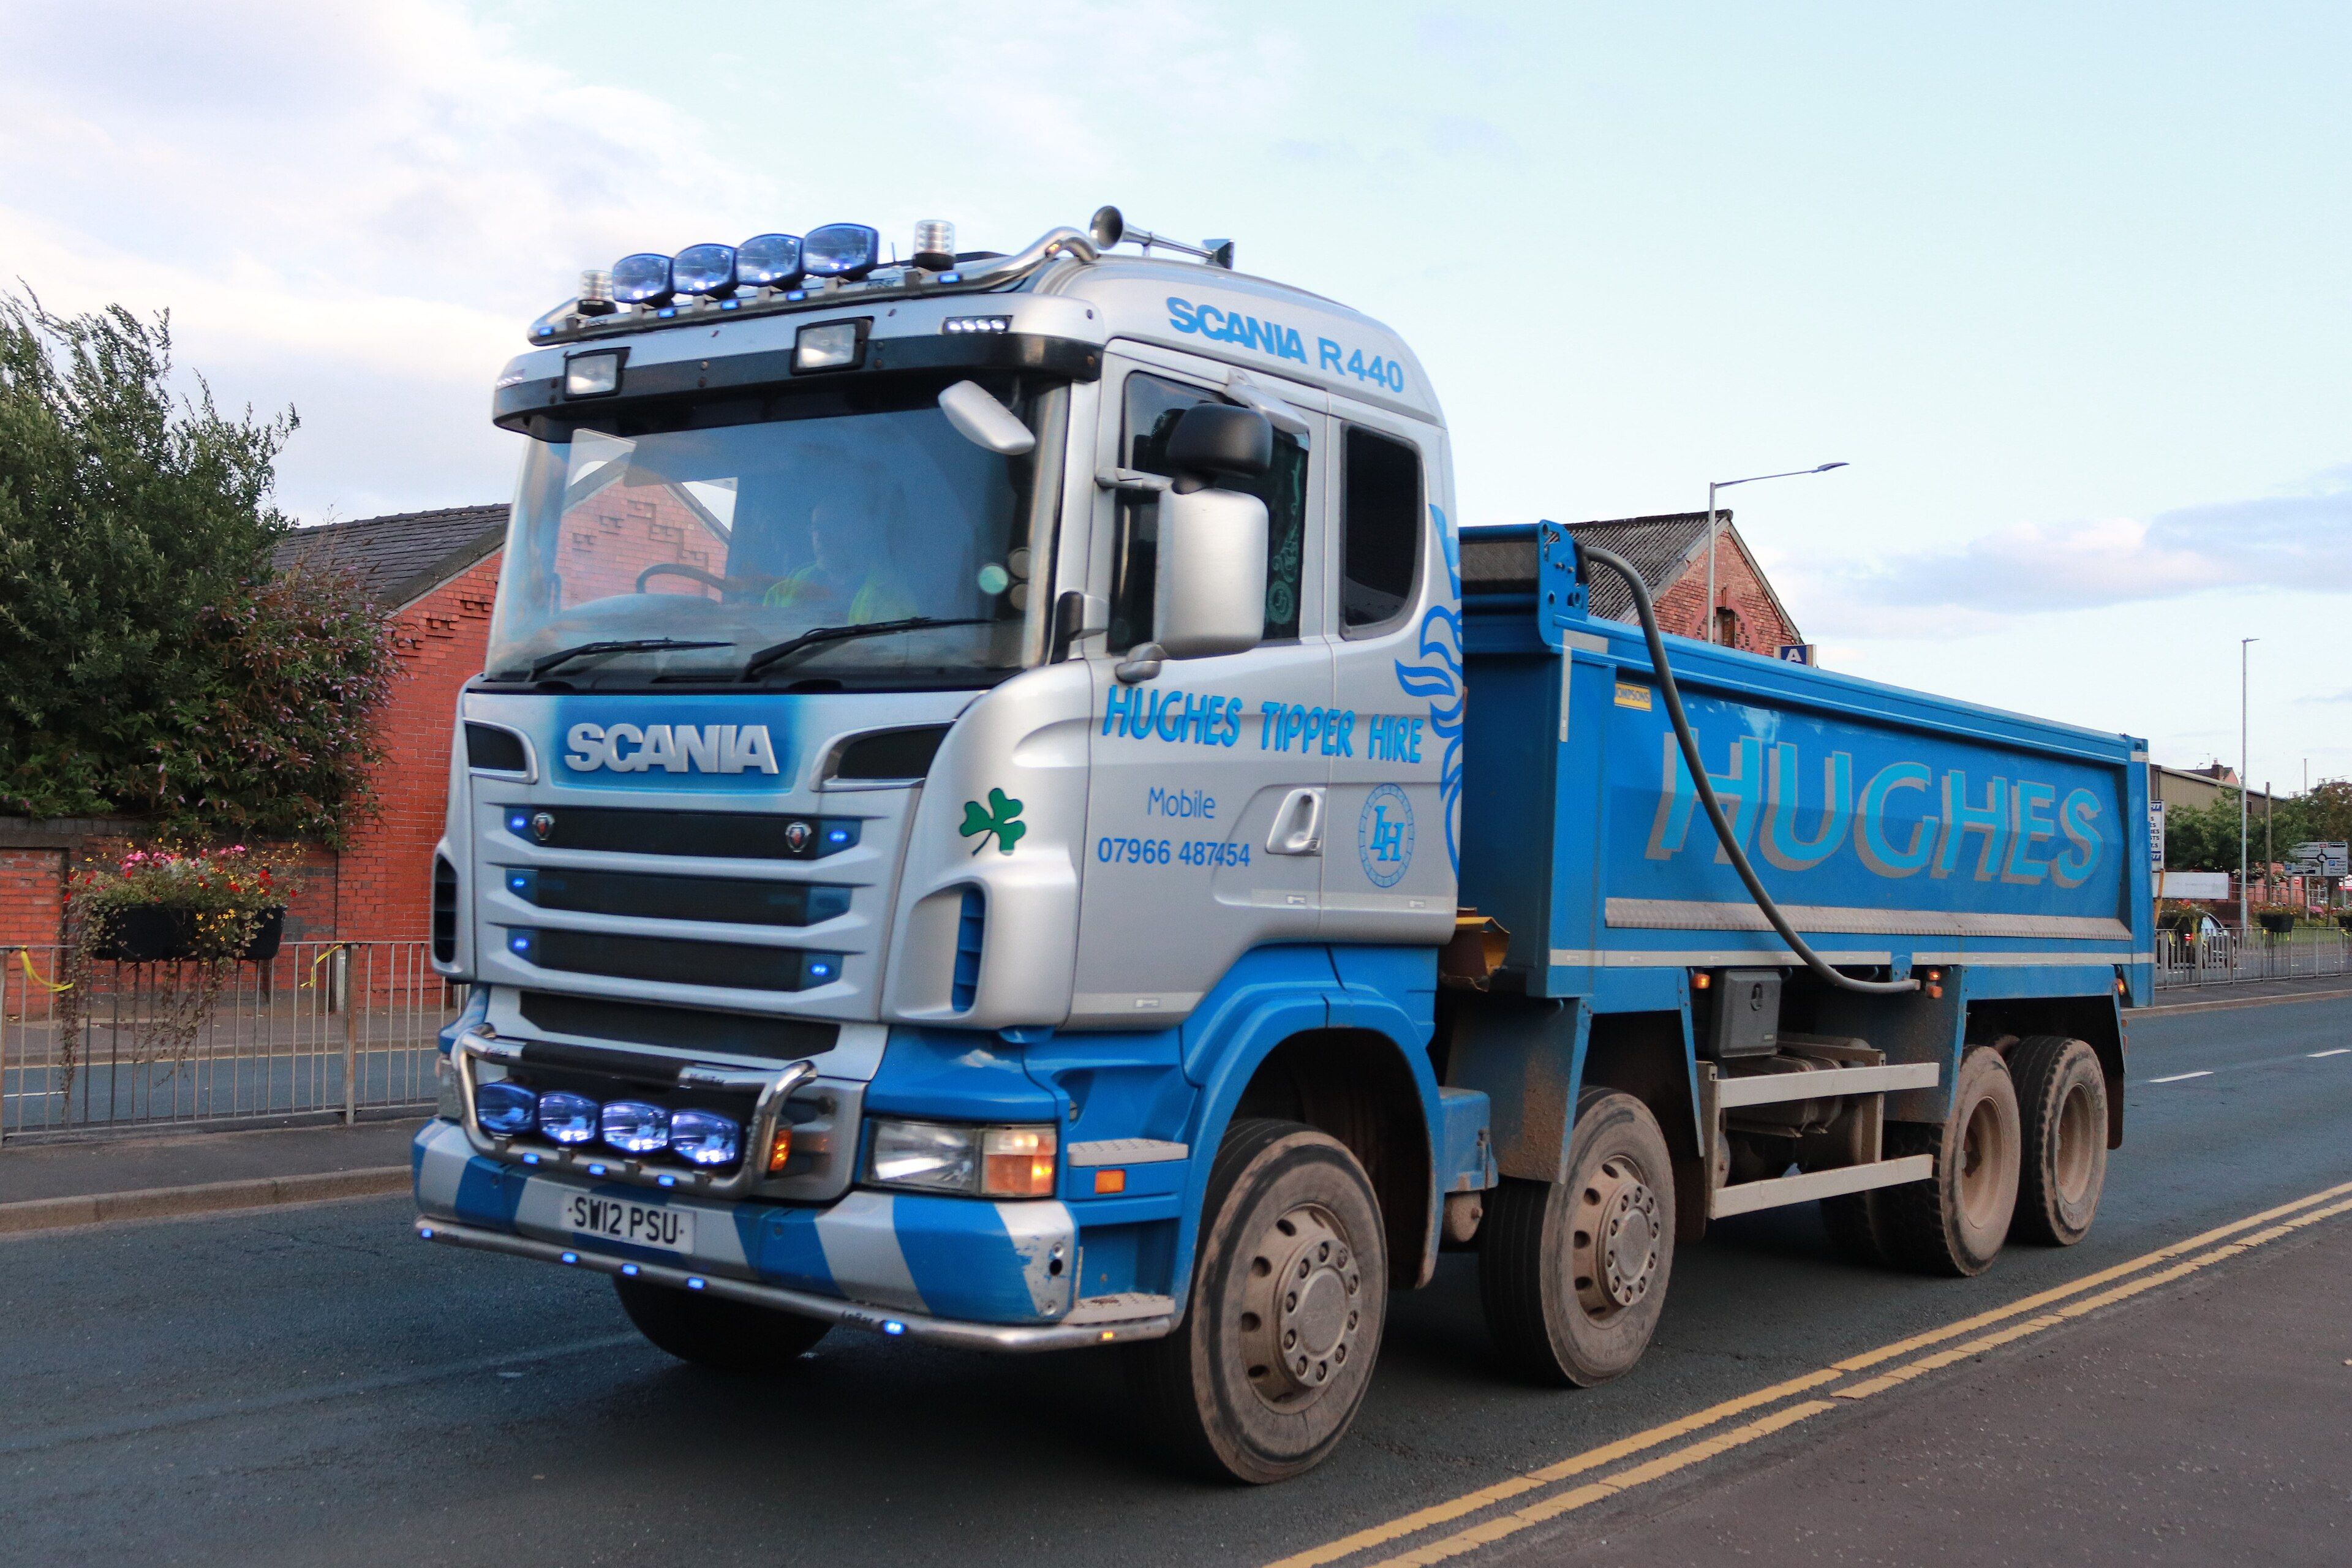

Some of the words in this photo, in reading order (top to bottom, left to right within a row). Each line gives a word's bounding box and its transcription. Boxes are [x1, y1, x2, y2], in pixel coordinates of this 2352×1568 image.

[1166, 296, 1308, 364] SCANIA
[1318, 336, 1404, 393] R440
[564, 723, 779, 774] SCANIA
[1102, 685, 1243, 747] HUGHES
[1261, 701, 1355, 758] TIPPER
[1368, 714, 1424, 763] HIRE
[1147, 786, 1216, 819] Mobile
[1644, 727, 2103, 888] HUGHES
[1098, 837, 1170, 864] 07966
[1178, 841, 1251, 867] 487454
[573, 1196, 622, 1235] SW12
[629, 1207, 678, 1245] PSU
